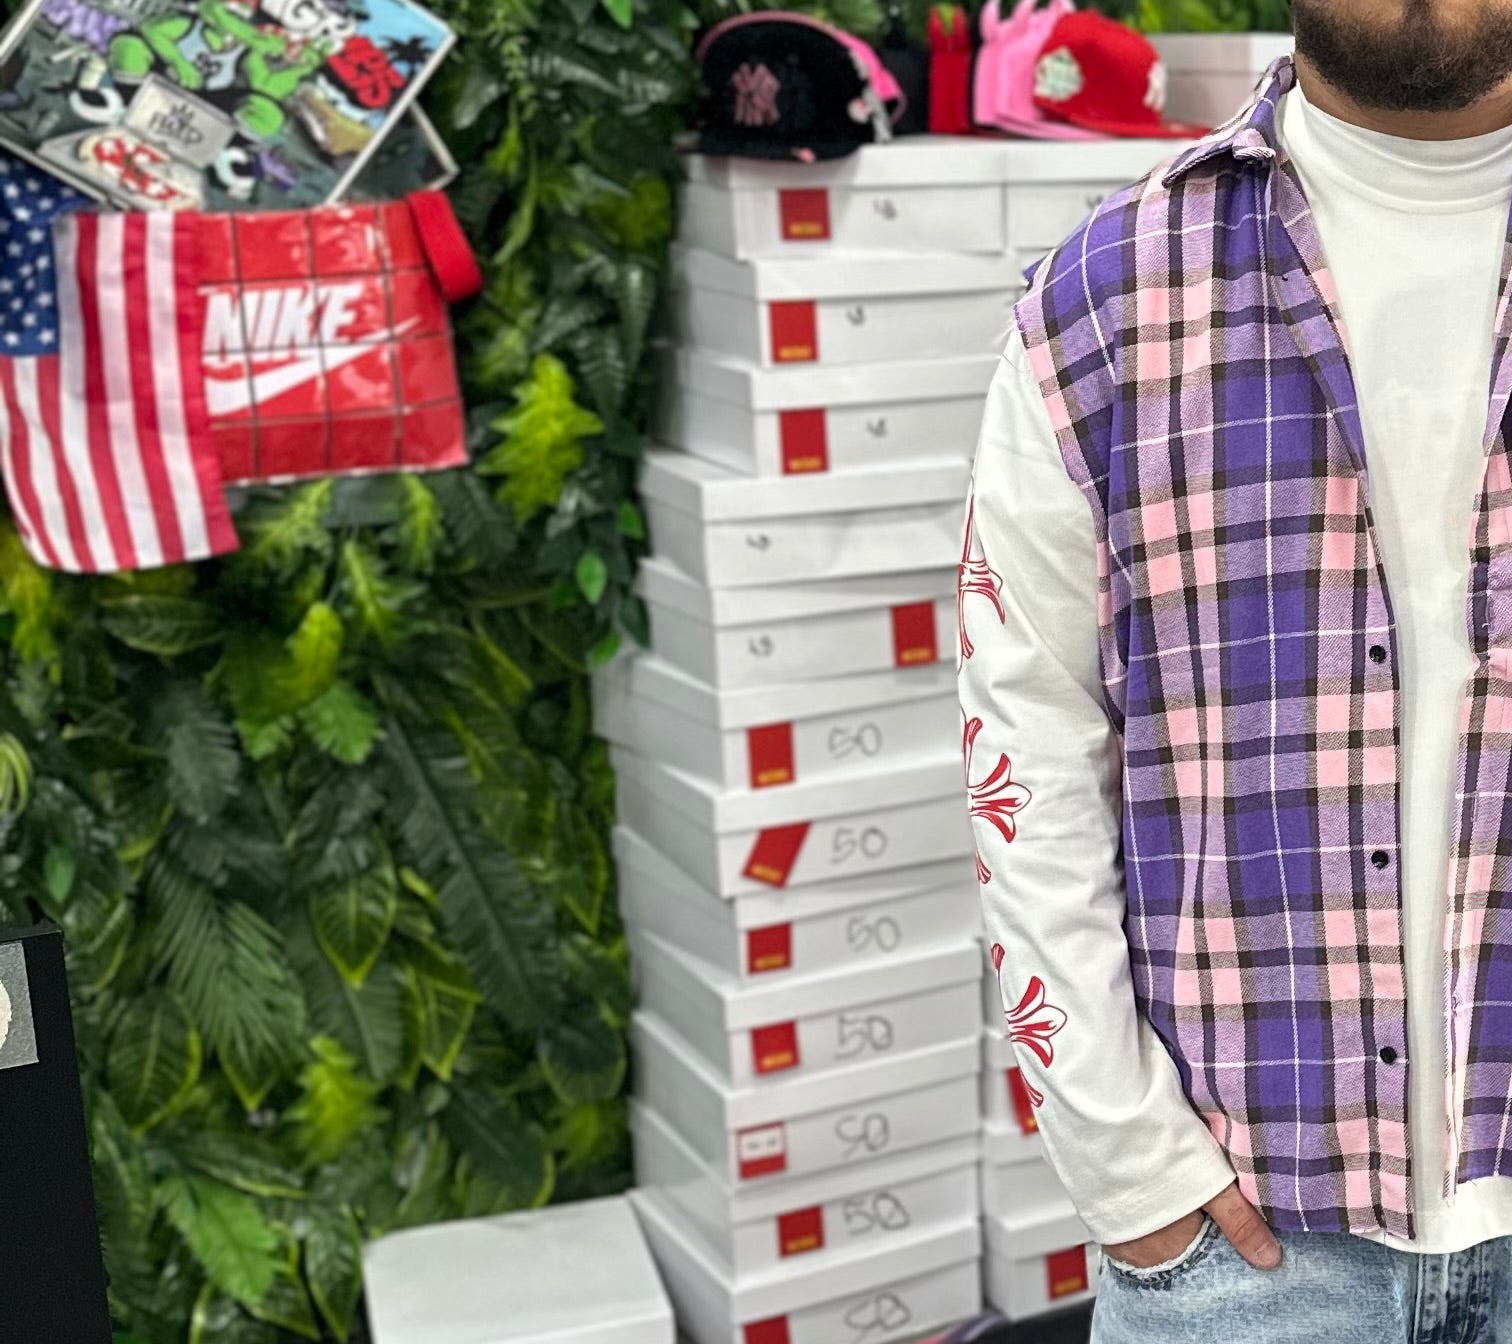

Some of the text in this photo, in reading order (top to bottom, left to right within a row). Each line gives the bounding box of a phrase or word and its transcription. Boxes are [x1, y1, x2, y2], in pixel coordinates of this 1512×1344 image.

[203, 280, 364, 362] NIKE
[830, 825, 888, 865] 50
[846, 915, 902, 953] 50
[843, 1192, 911, 1236] 50
